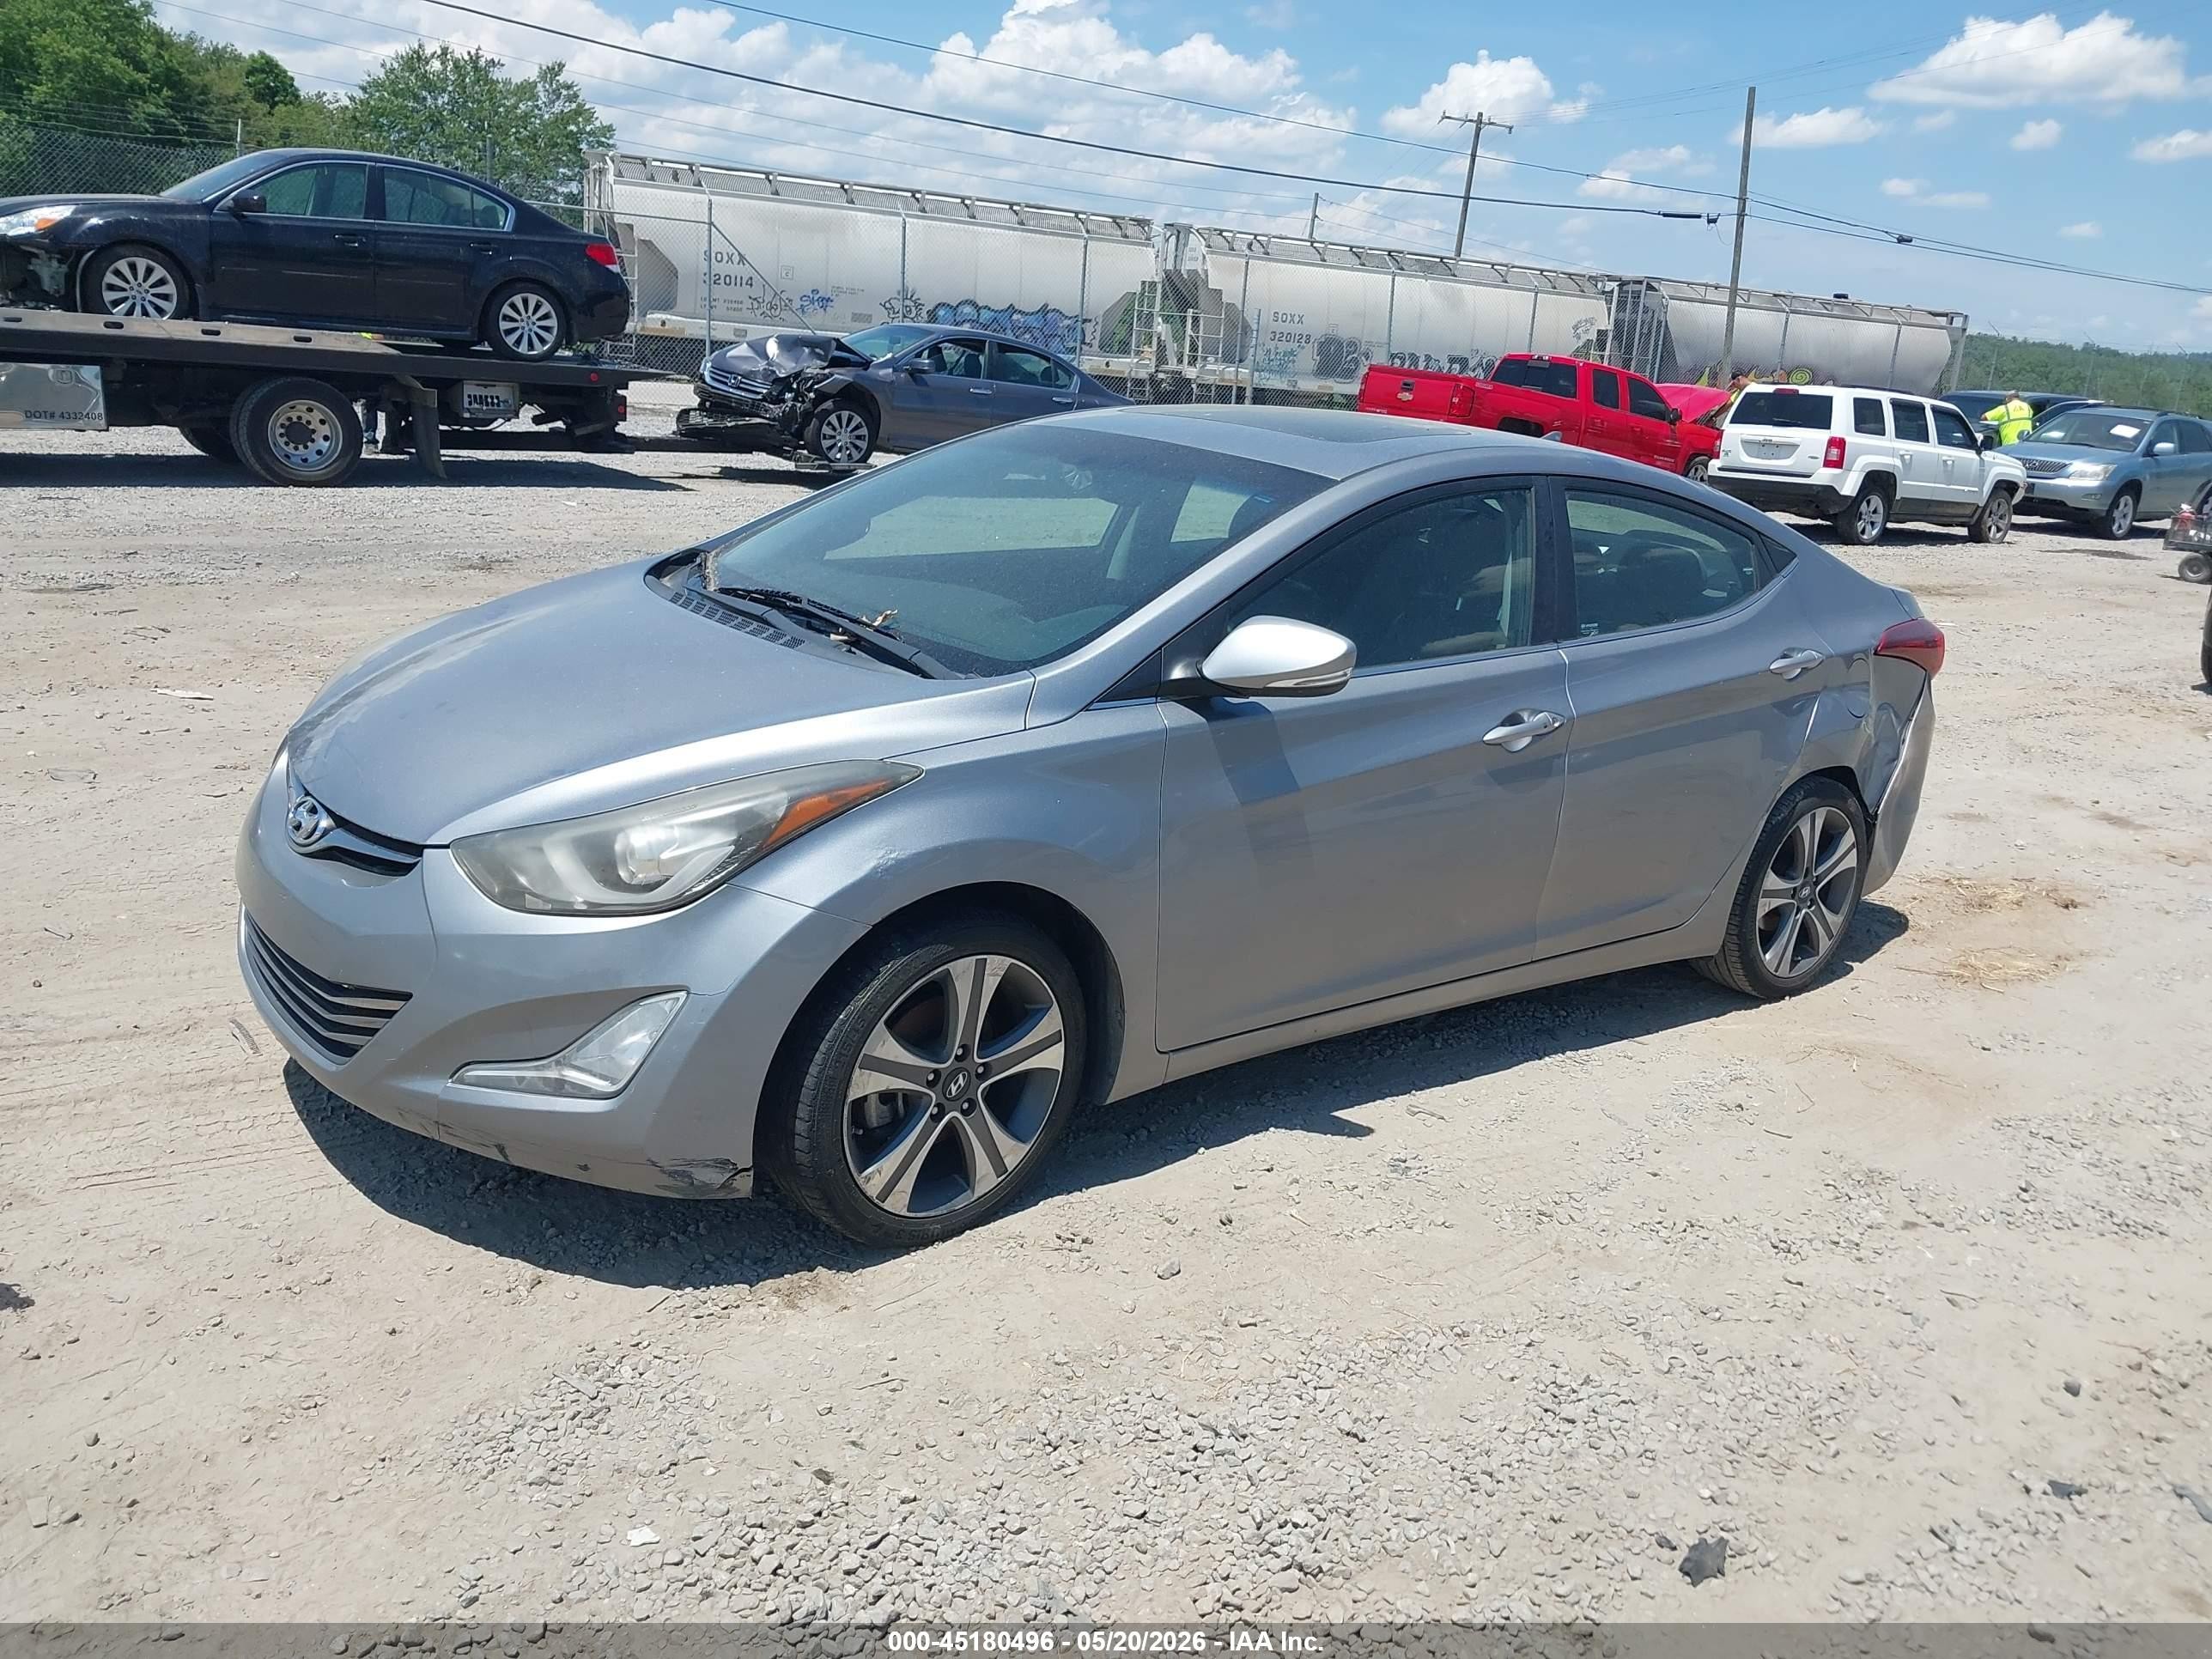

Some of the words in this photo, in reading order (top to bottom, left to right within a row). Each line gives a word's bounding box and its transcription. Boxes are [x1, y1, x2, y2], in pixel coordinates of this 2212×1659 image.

[1273, 311, 1304, 325] SOXX
[1270, 331, 1311, 344] 320128
[24, 410, 55, 419] DOT#
[58, 411, 103, 421] 4332408
